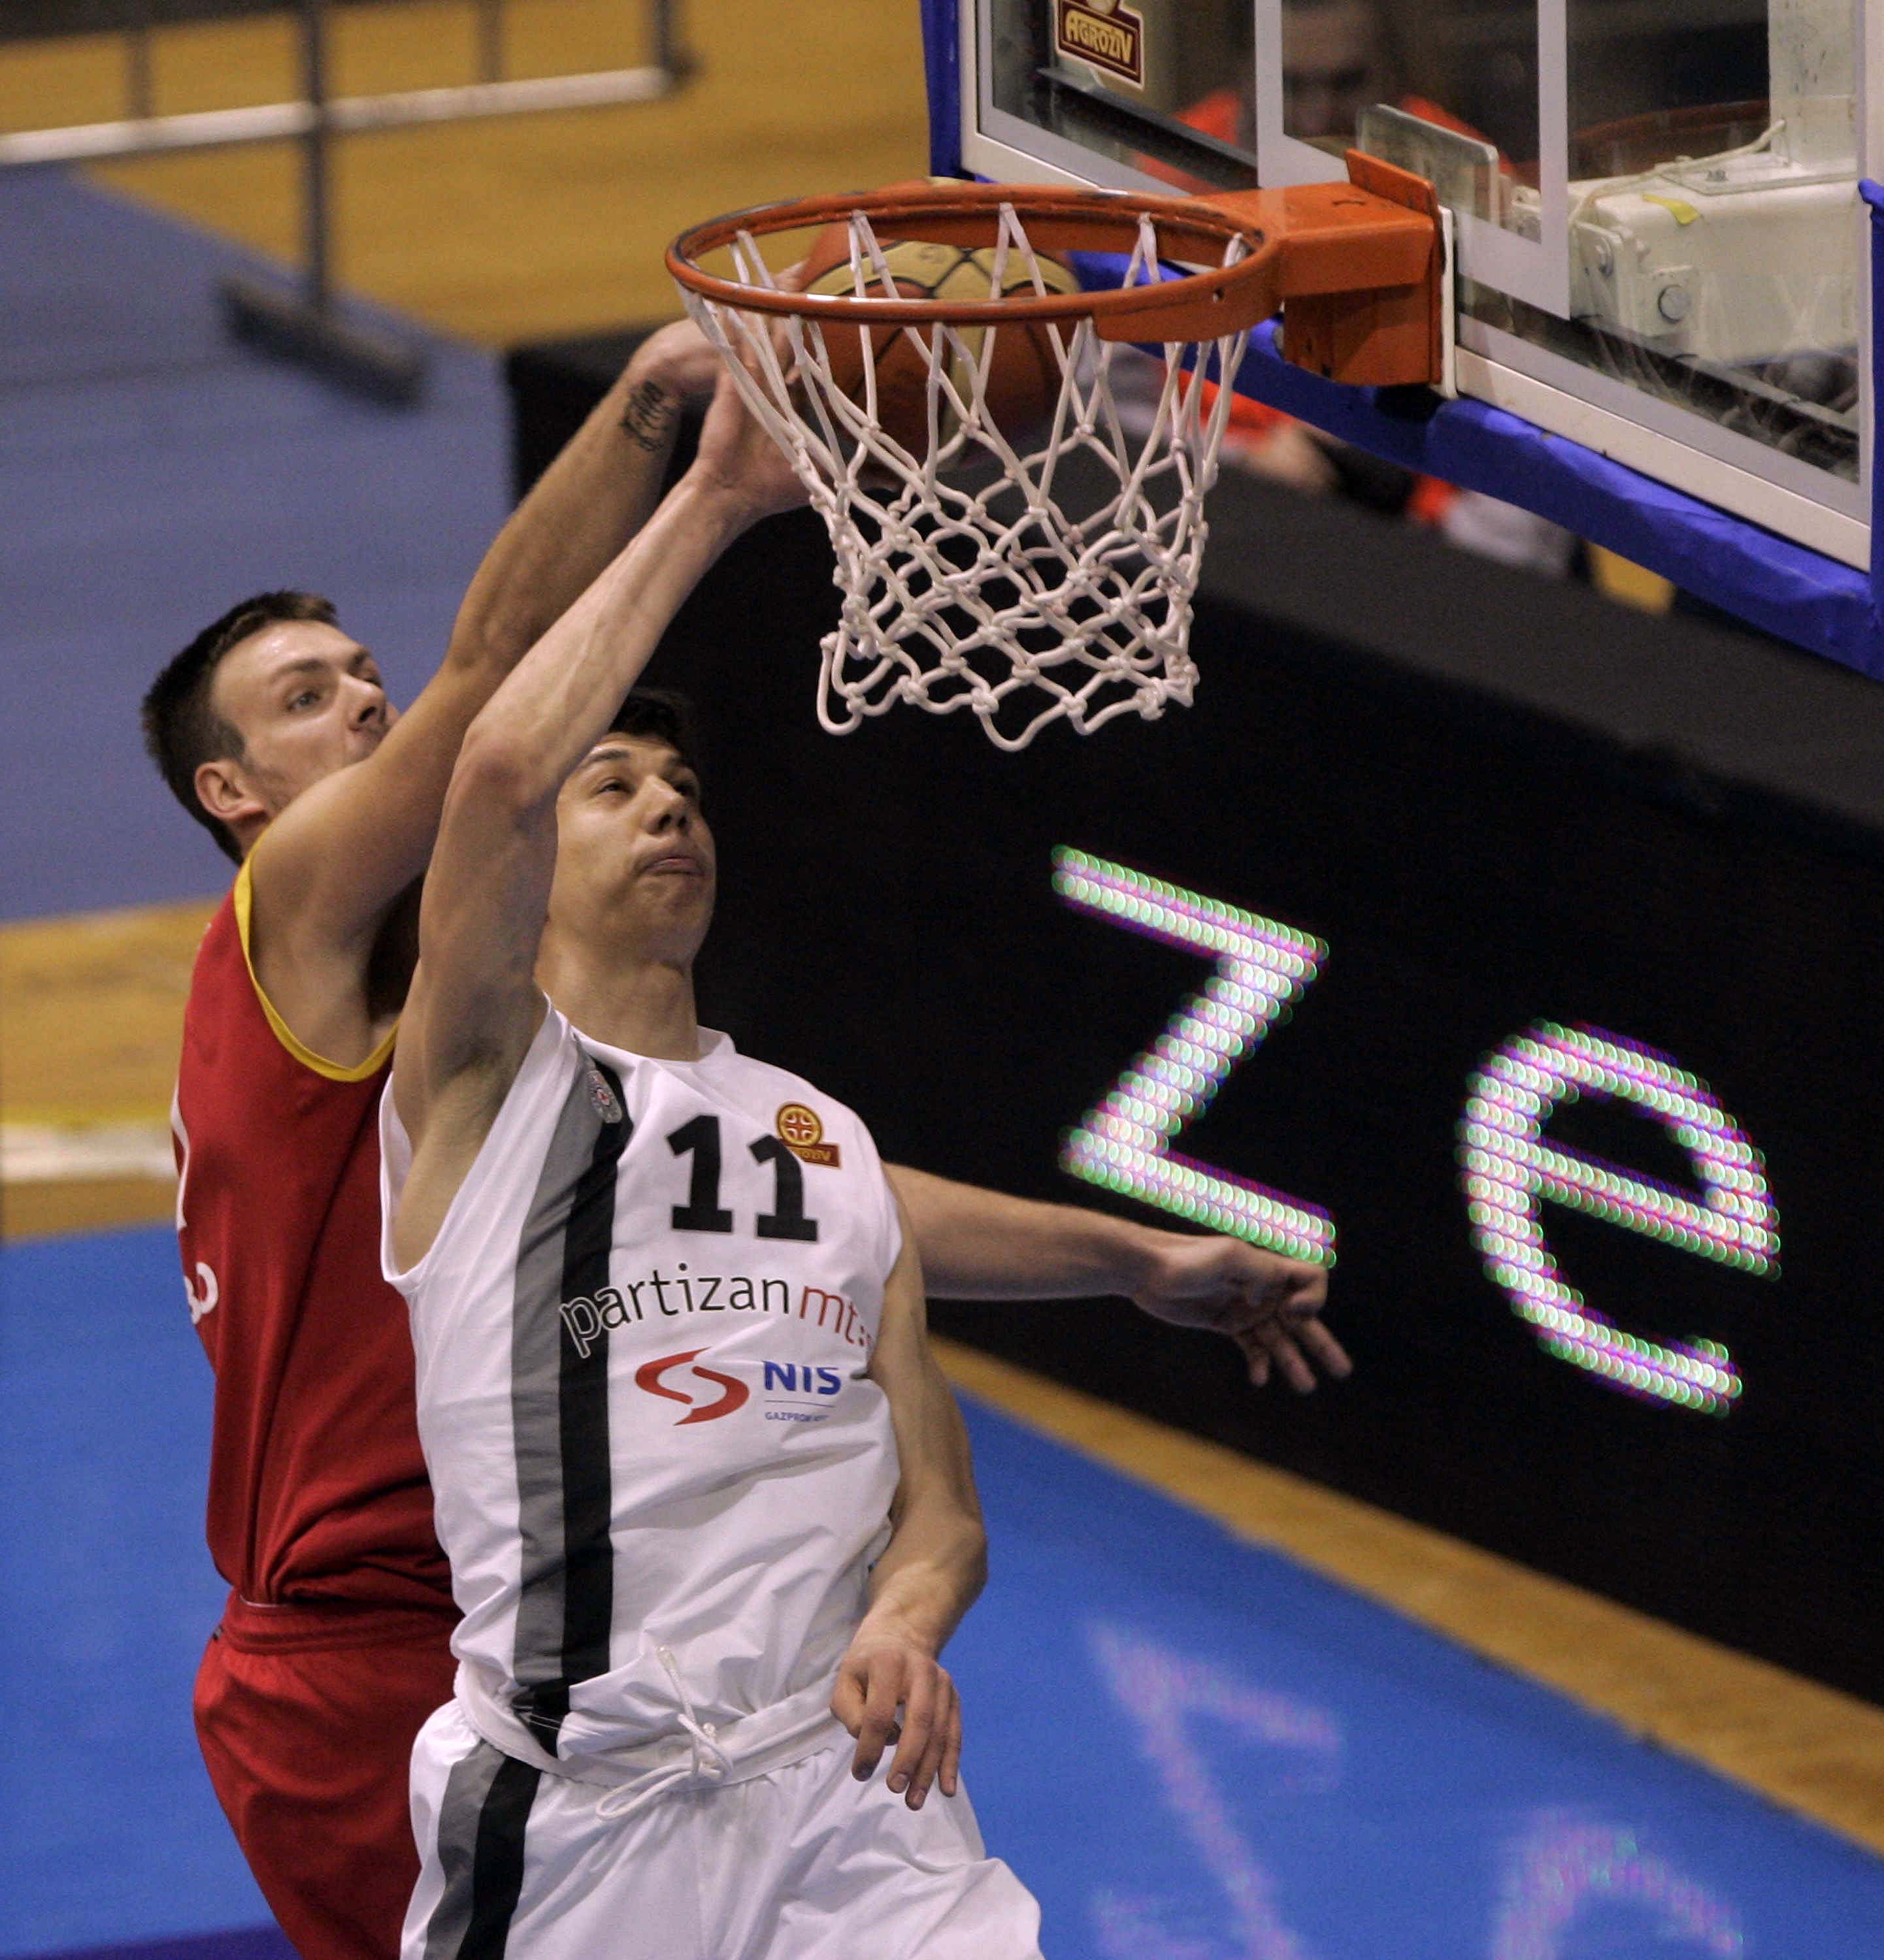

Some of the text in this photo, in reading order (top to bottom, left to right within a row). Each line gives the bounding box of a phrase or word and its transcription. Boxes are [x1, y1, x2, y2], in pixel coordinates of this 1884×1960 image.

[665, 1115, 818, 1242] 11
[560, 1263, 789, 1359] partizan
[761, 1360, 841, 1396] NIS
